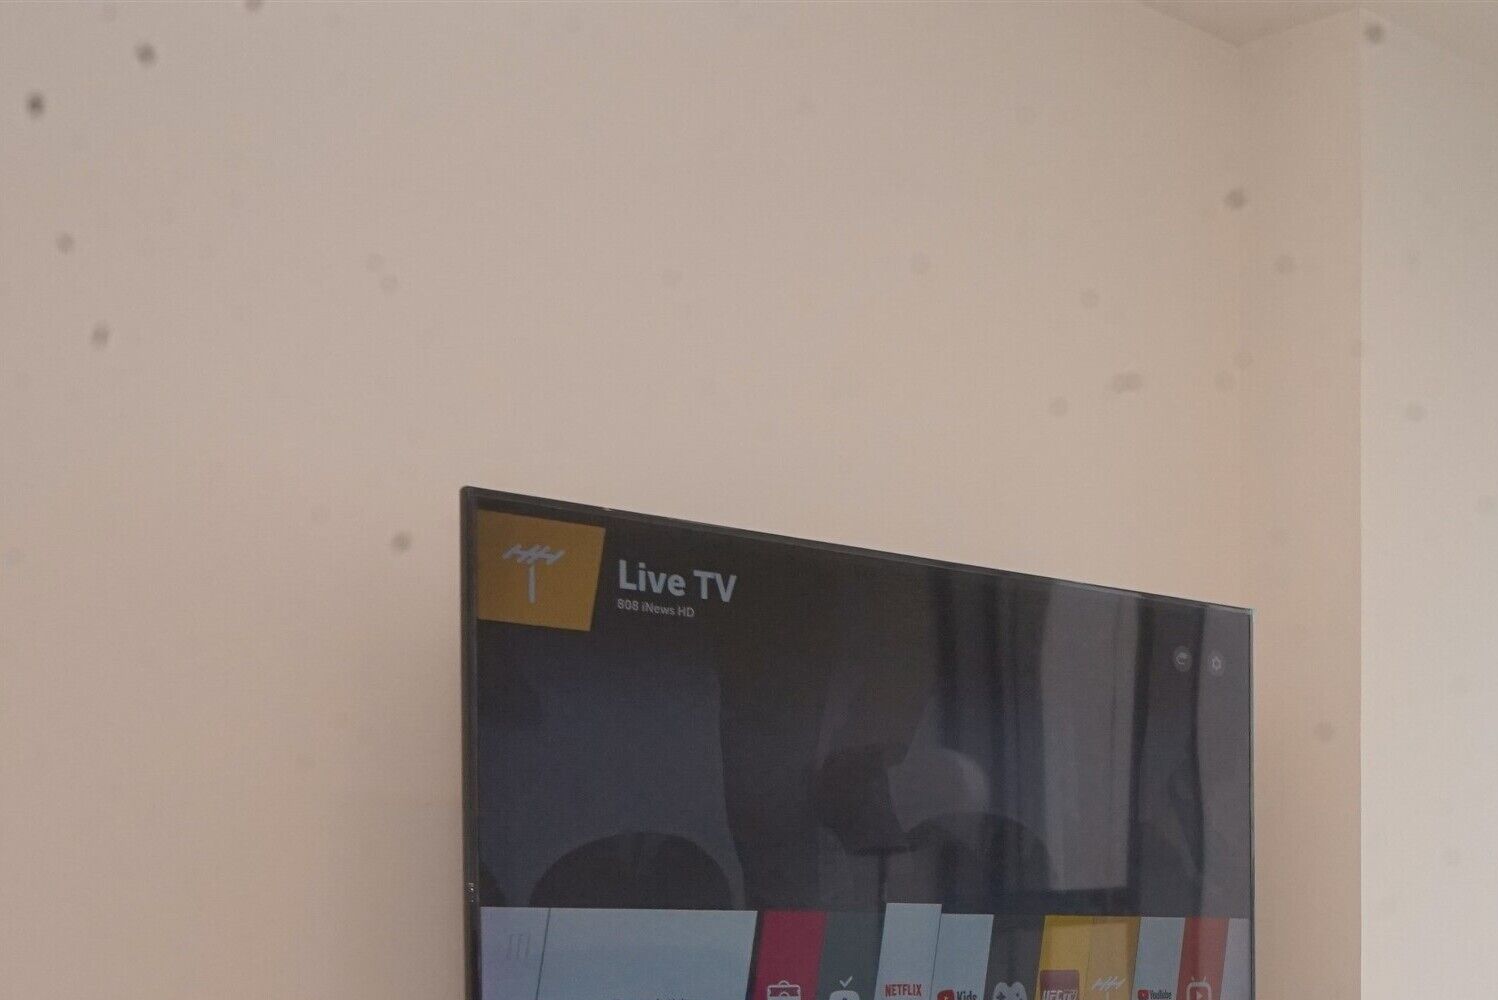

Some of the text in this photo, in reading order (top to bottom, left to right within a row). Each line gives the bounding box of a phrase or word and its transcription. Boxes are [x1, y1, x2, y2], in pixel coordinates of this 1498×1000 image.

[619, 559, 737, 603] Live TV
[617, 598, 695, 618] 808 iNews HD
[885, 984, 922, 997] NETFLIX
[1149, 989, 1172, 1000] YouTube
